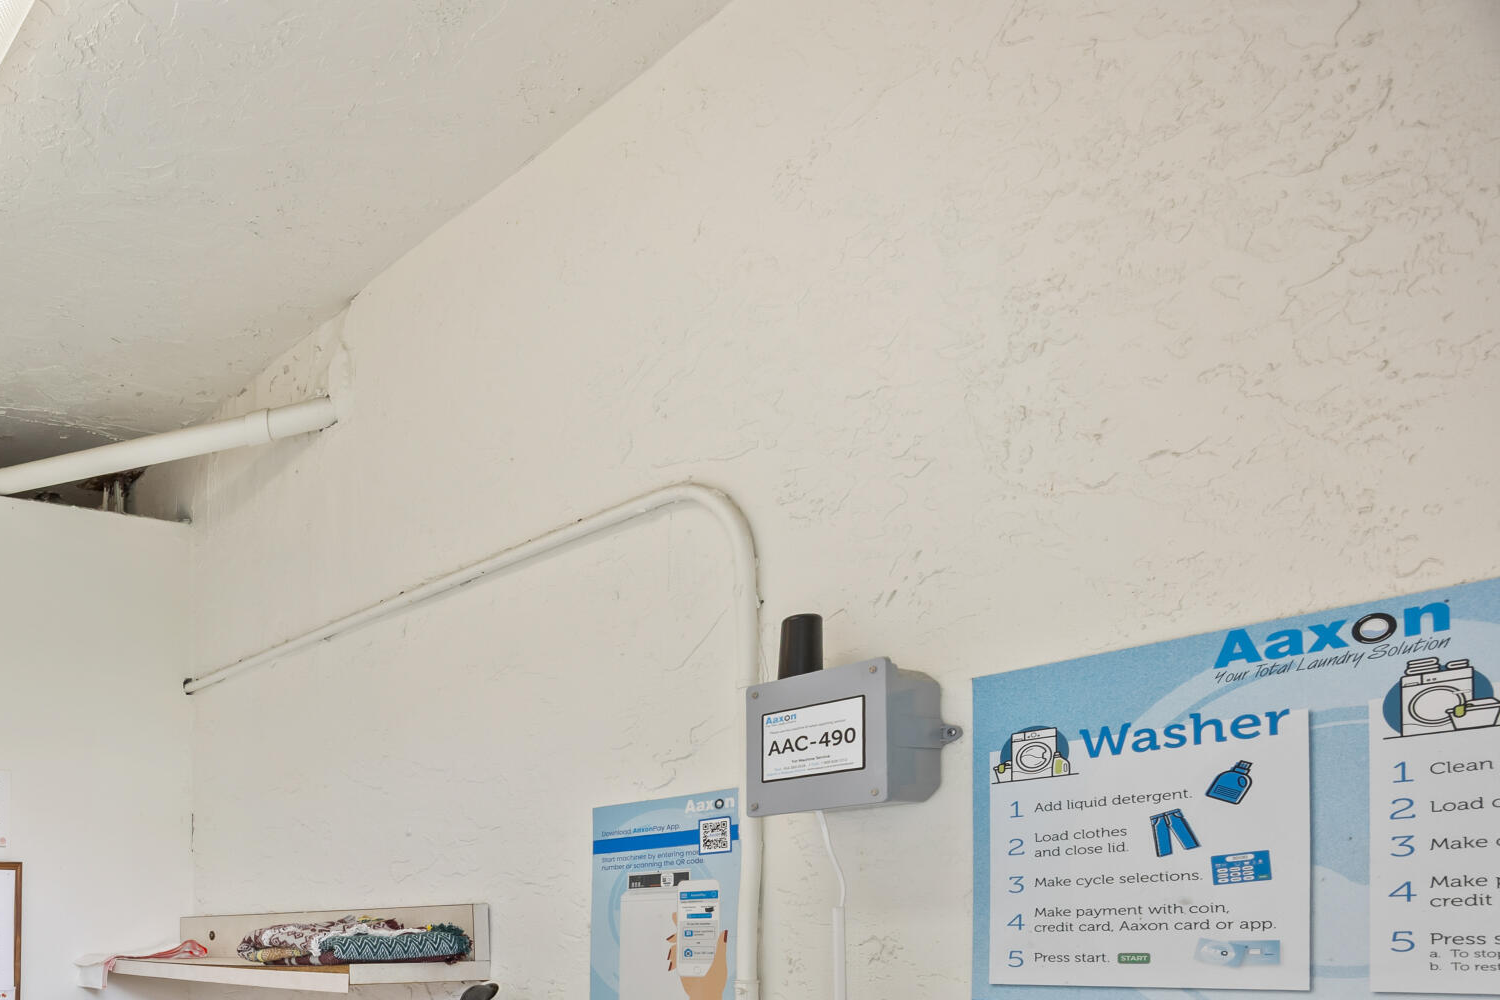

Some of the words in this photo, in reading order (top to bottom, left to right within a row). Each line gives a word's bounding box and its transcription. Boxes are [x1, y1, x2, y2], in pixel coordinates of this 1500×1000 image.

[1214, 602, 1450, 669] Aaxon
[1214, 670, 1250, 684] Your
[1255, 660, 1294, 678] Total
[1296, 650, 1364, 672] Laundry
[1367, 636, 1452, 660] Solution
[766, 713, 797, 725] Aaxon
[768, 727, 856, 756] AAC-490
[1079, 708, 1290, 758] Washer
[1392, 761, 1414, 783] 1
[1430, 760, 1494, 774] Clean
[684, 797, 734, 814] Aaxon
[1010, 800, 1024, 818] 1
[1034, 802, 1062, 813] Add
[1067, 796, 1107, 811] liquid
[1112, 789, 1193, 804] detergent.
[1389, 797, 1416, 820] 2
[1430, 797, 1484, 812] Load
[601, 828, 631, 837] Download
[1008, 838, 1025, 856] 2
[1035, 830, 1069, 843] Load
[1073, 827, 1127, 840] clothes
[658, 850, 684, 859] entering
[1034, 846, 1060, 857] and
[1065, 843, 1103, 854] close
[1108, 842, 1129, 852] lid.
[1390, 835, 1414, 857] 3
[1430, 836, 1488, 850] Make
[1008, 876, 1024, 894] 3
[1034, 876, 1072, 888] Make
[1076, 874, 1115, 888] cycle
[1119, 871, 1203, 884] selections.
[1388, 881, 1417, 902] 4
[1430, 875, 1488, 888] Make
[1430, 894, 1492, 908] credit
[1006, 914, 1025, 931] 4
[1034, 906, 1072, 918] Make
[1076, 905, 1143, 920] payment
[1148, 904, 1184, 915] with
[1189, 903, 1230, 916] coin,
[1034, 921, 1074, 933] credit
[1119, 920, 1169, 931] Aaxon
[1174, 919, 1210, 931] card
[1216, 920, 1234, 930] or
[1239, 920, 1276, 932] app.
[1390, 931, 1415, 952] 5
[1430, 933, 1486, 945] Press
[1008, 950, 1024, 968] 5
[1034, 952, 1071, 963] Press
[1075, 952, 1110, 963] start.
[1450, 949, 1469, 958] To
[1474, 950, 1500, 960] sto
[1450, 962, 1470, 971] To
